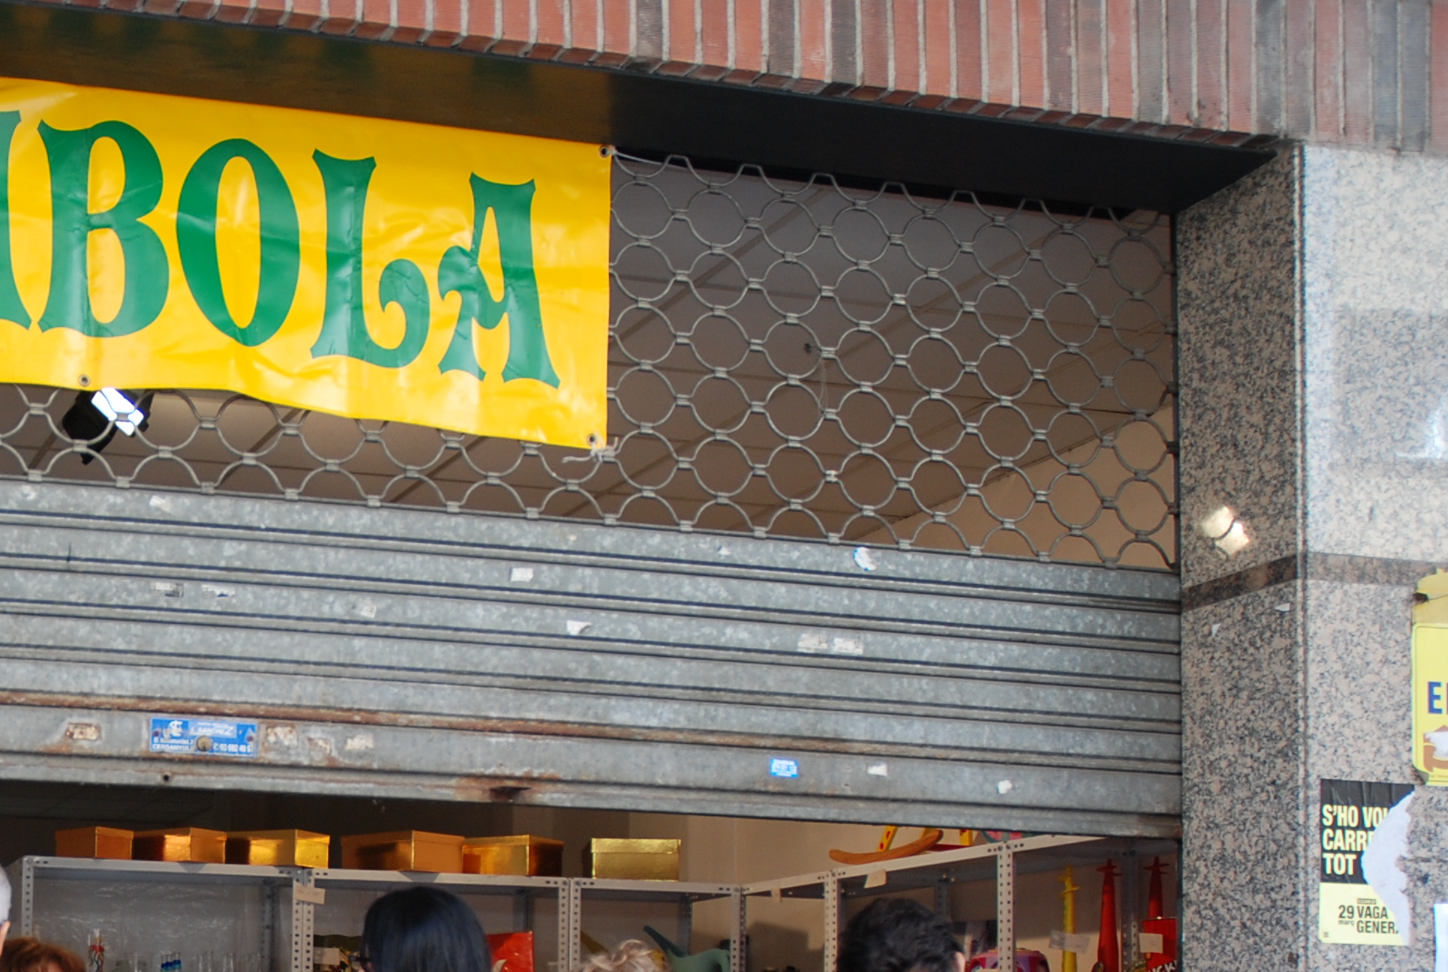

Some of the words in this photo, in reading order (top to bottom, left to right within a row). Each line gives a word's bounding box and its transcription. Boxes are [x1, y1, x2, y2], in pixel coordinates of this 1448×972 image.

[1428, 681, 1448, 715] E
[1322, 853, 1357, 876] TOT
[1338, 905, 1355, 919] 29
[1357, 906, 1389, 920] VAGA
[1356, 920, 1399, 934] GENER
